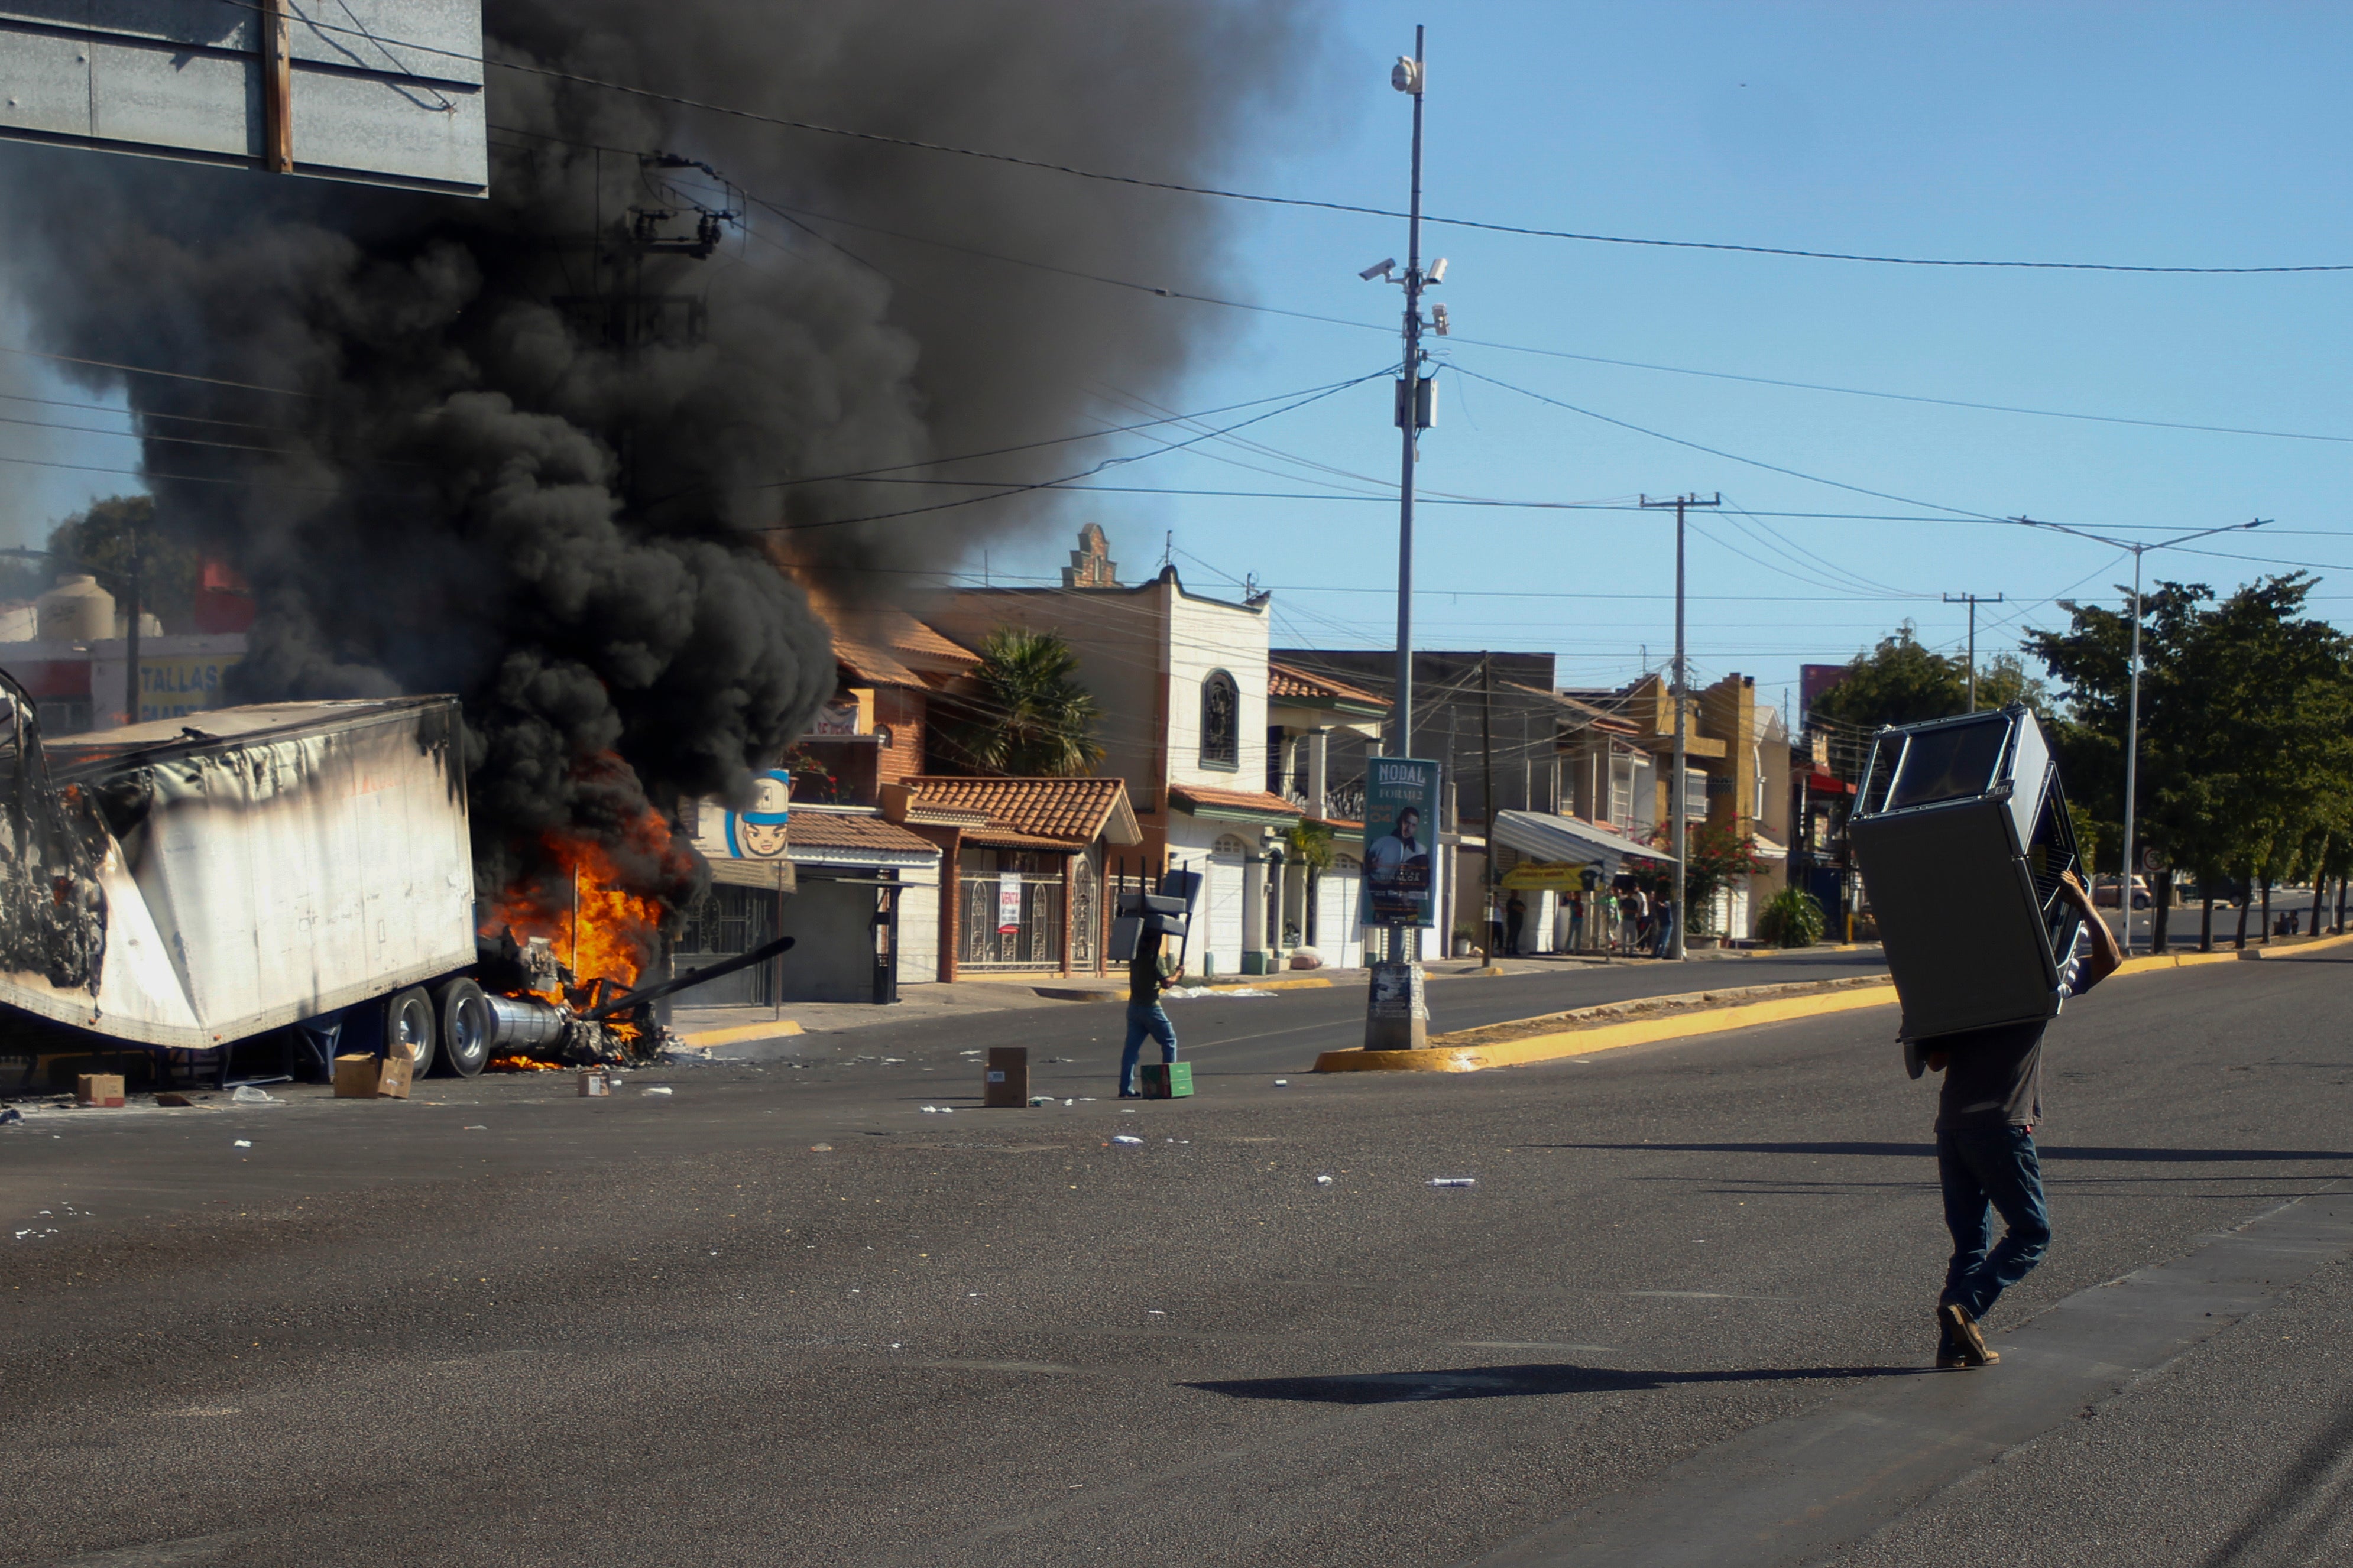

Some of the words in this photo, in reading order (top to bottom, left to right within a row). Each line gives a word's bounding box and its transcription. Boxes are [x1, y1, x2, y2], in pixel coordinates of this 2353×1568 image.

[140, 665, 218, 692] TALLAS
[1379, 764, 1425, 784] NODAL
[1370, 813, 1391, 822] 04
[1001, 892, 1019, 905] VENTA
